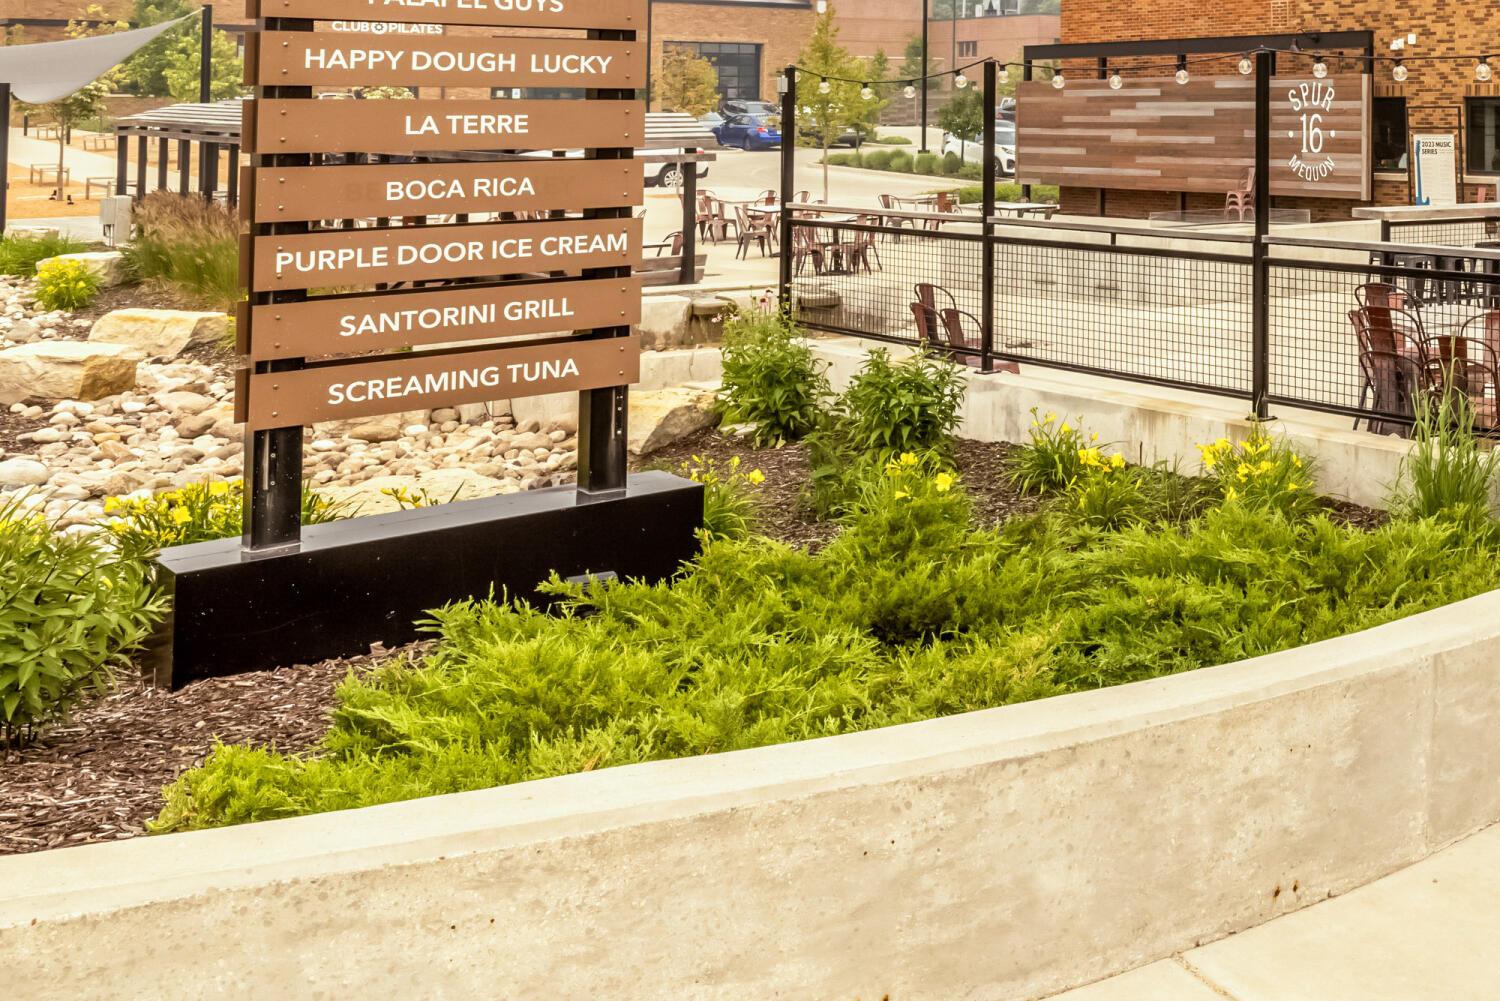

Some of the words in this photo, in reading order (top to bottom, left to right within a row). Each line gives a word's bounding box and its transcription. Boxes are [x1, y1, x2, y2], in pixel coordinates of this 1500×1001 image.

[331, 20, 370, 33] CLUB
[388, 22, 443, 35] PILATES
[304, 48, 405, 71] HAPPY
[411, 51, 516, 73] DOUGH
[530, 53, 613, 75] LUCKY
[1288, 82, 1335, 112] SPUR
[405, 115, 440, 135] LA
[445, 114, 529, 135] TERRE
[1300, 113, 1323, 153] 16
[1288, 154, 1336, 182] MEQUON
[386, 178, 466, 202] BOCA
[473, 177, 536, 198] RICA
[275, 246, 389, 274] PURPLE
[397, 241, 484, 265] DOOR
[492, 238, 533, 260] ICE
[540, 232, 628, 256] CREAM
[339, 303, 497, 337] SANTORINI
[503, 297, 575, 321] GRILL
[327, 366, 500, 405] SCREAMING
[506, 358, 580, 384] TUNA
